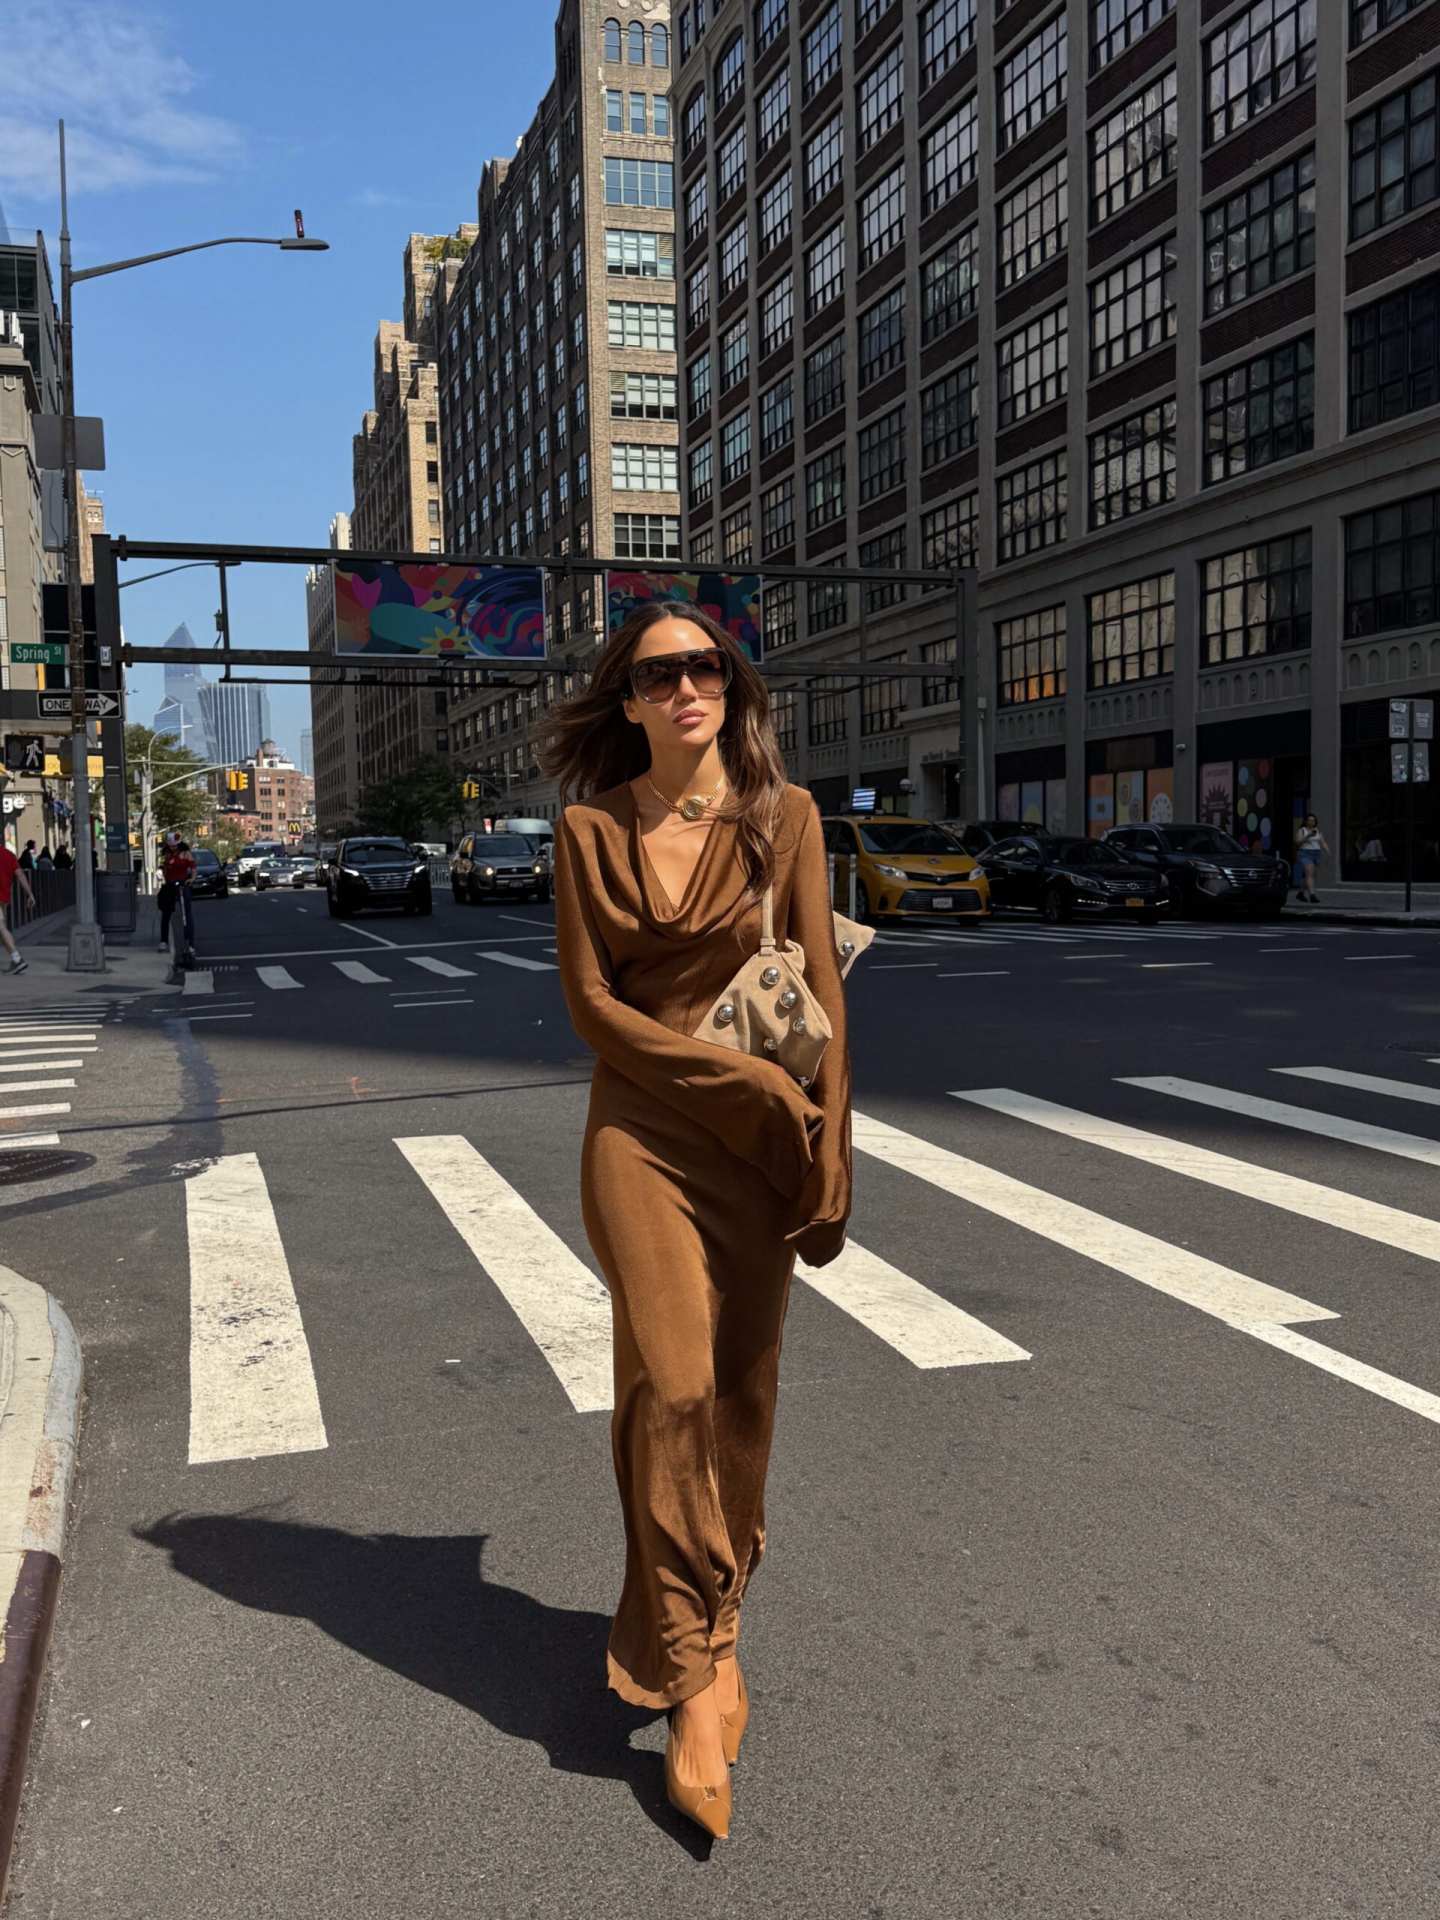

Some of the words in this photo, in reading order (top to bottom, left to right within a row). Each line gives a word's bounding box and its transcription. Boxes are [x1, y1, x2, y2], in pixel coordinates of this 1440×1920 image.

[15, 645, 50, 663] Spring
[45, 699, 70, 710] ONE
[84, 698, 109, 710] WAY
